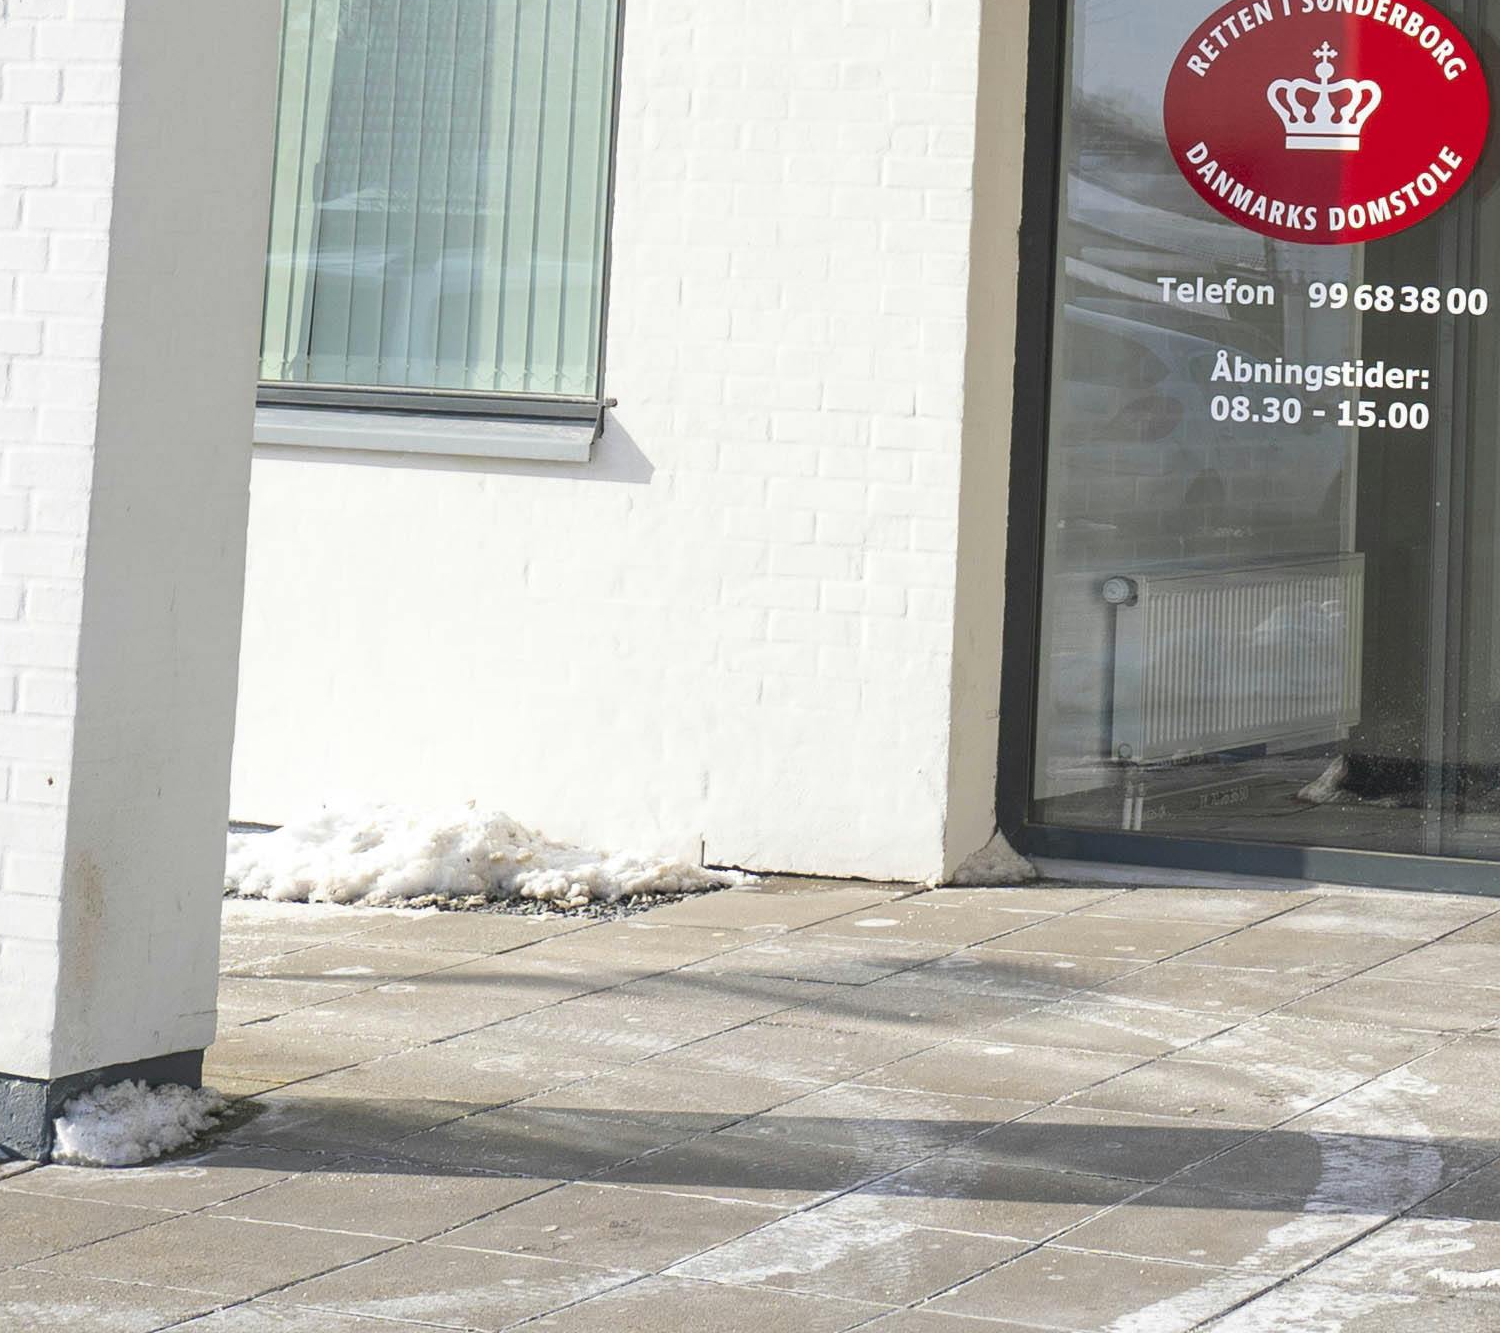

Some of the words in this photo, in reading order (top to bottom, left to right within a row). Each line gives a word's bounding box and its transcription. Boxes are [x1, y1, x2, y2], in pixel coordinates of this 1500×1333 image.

[1187, 0, 1273, 77] RETTEN
[1186, 141, 1317, 231] DANMARKS
[1328, 145, 1463, 231] DOMSTOLE
[1157, 277, 1274, 306] Telefon
[1210, 349, 1430, 392] Åbningstider:
[1210, 395, 1302, 424] 08.30
[1337, 400, 1430, 430] 15.00
